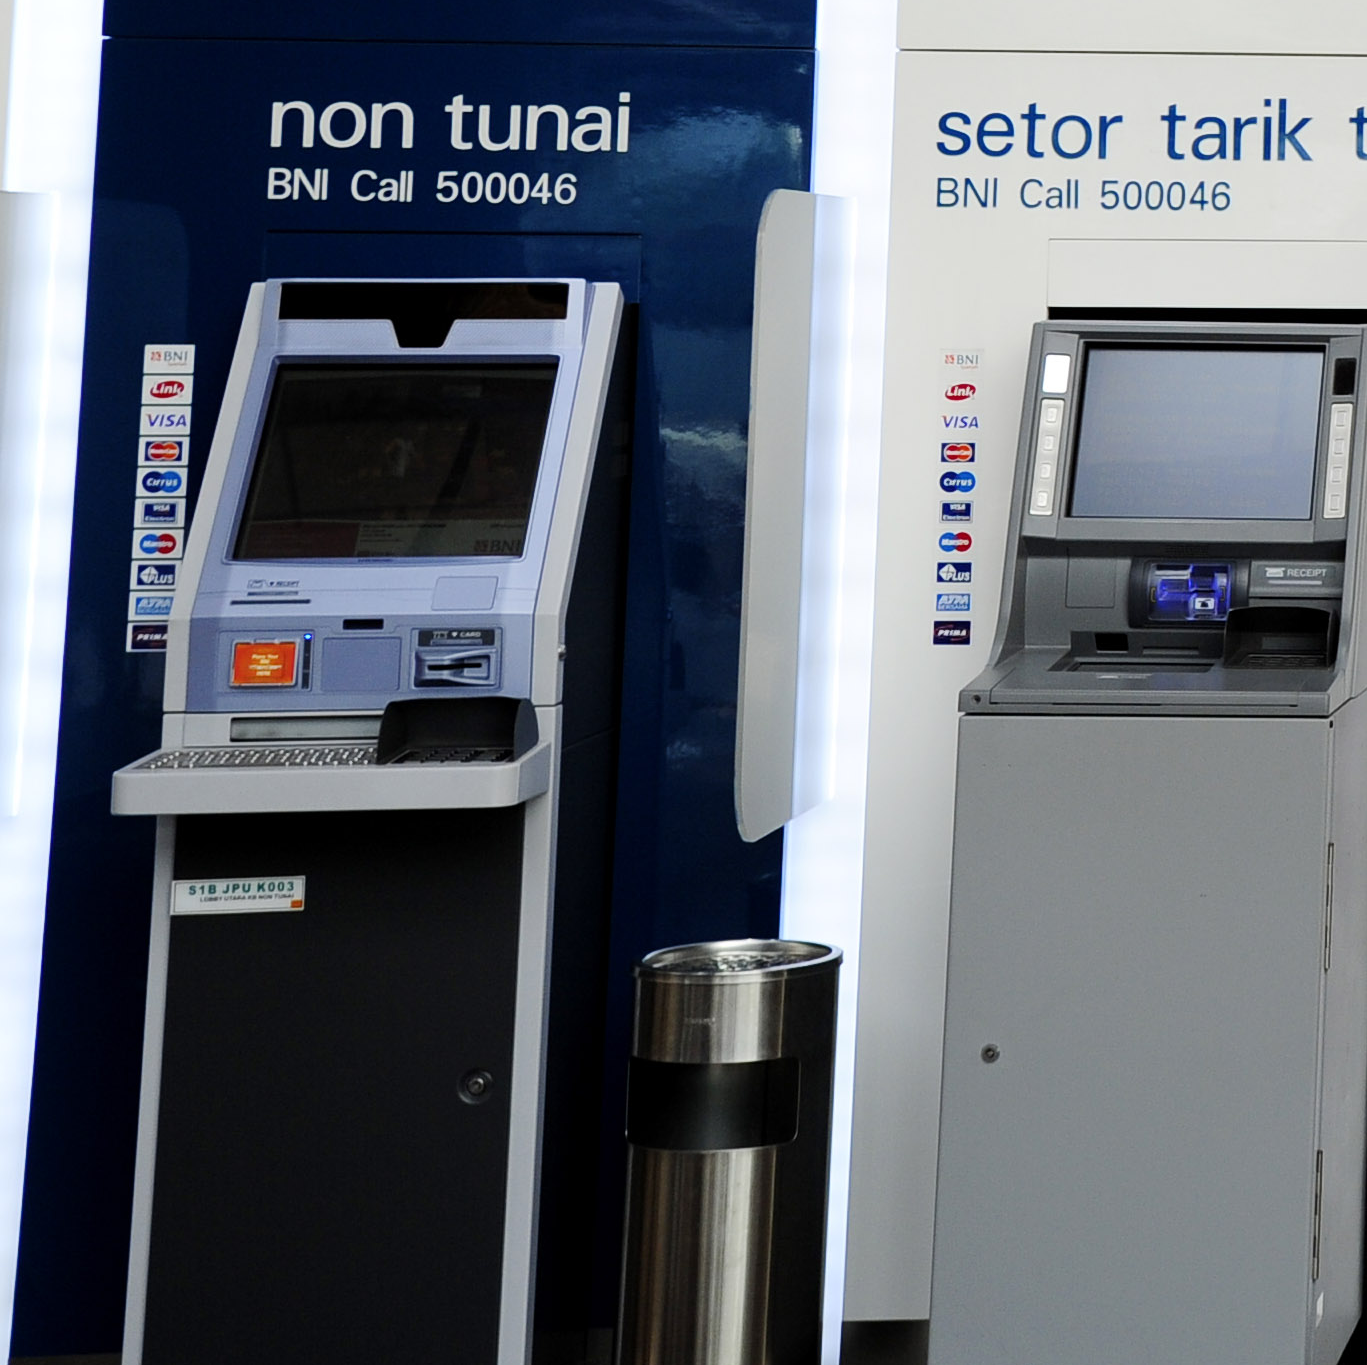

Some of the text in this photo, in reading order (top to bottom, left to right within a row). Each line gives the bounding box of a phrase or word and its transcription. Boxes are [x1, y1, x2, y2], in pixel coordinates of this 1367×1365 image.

[270, 92, 630, 152] non tunai
[937, 103, 1123, 159] setor
[1161, 99, 1312, 161] tarik
[268, 168, 577, 204] BNI Call 500046
[937, 178, 1230, 211] BNI Call 500046
[164, 351, 188, 361] BNI
[957, 355, 978, 364] BNI
[152, 381, 183, 396] Link
[947, 386, 974, 398] Link
[146, 414, 186, 427] VISA
[942, 415, 979, 428] VISA
[146, 477, 178, 486] Cirrus
[943, 478, 972, 486] Cirrus
[1287, 568, 1327, 577] RECEIPT
[189, 881, 295, 895] S1B JPU K003
